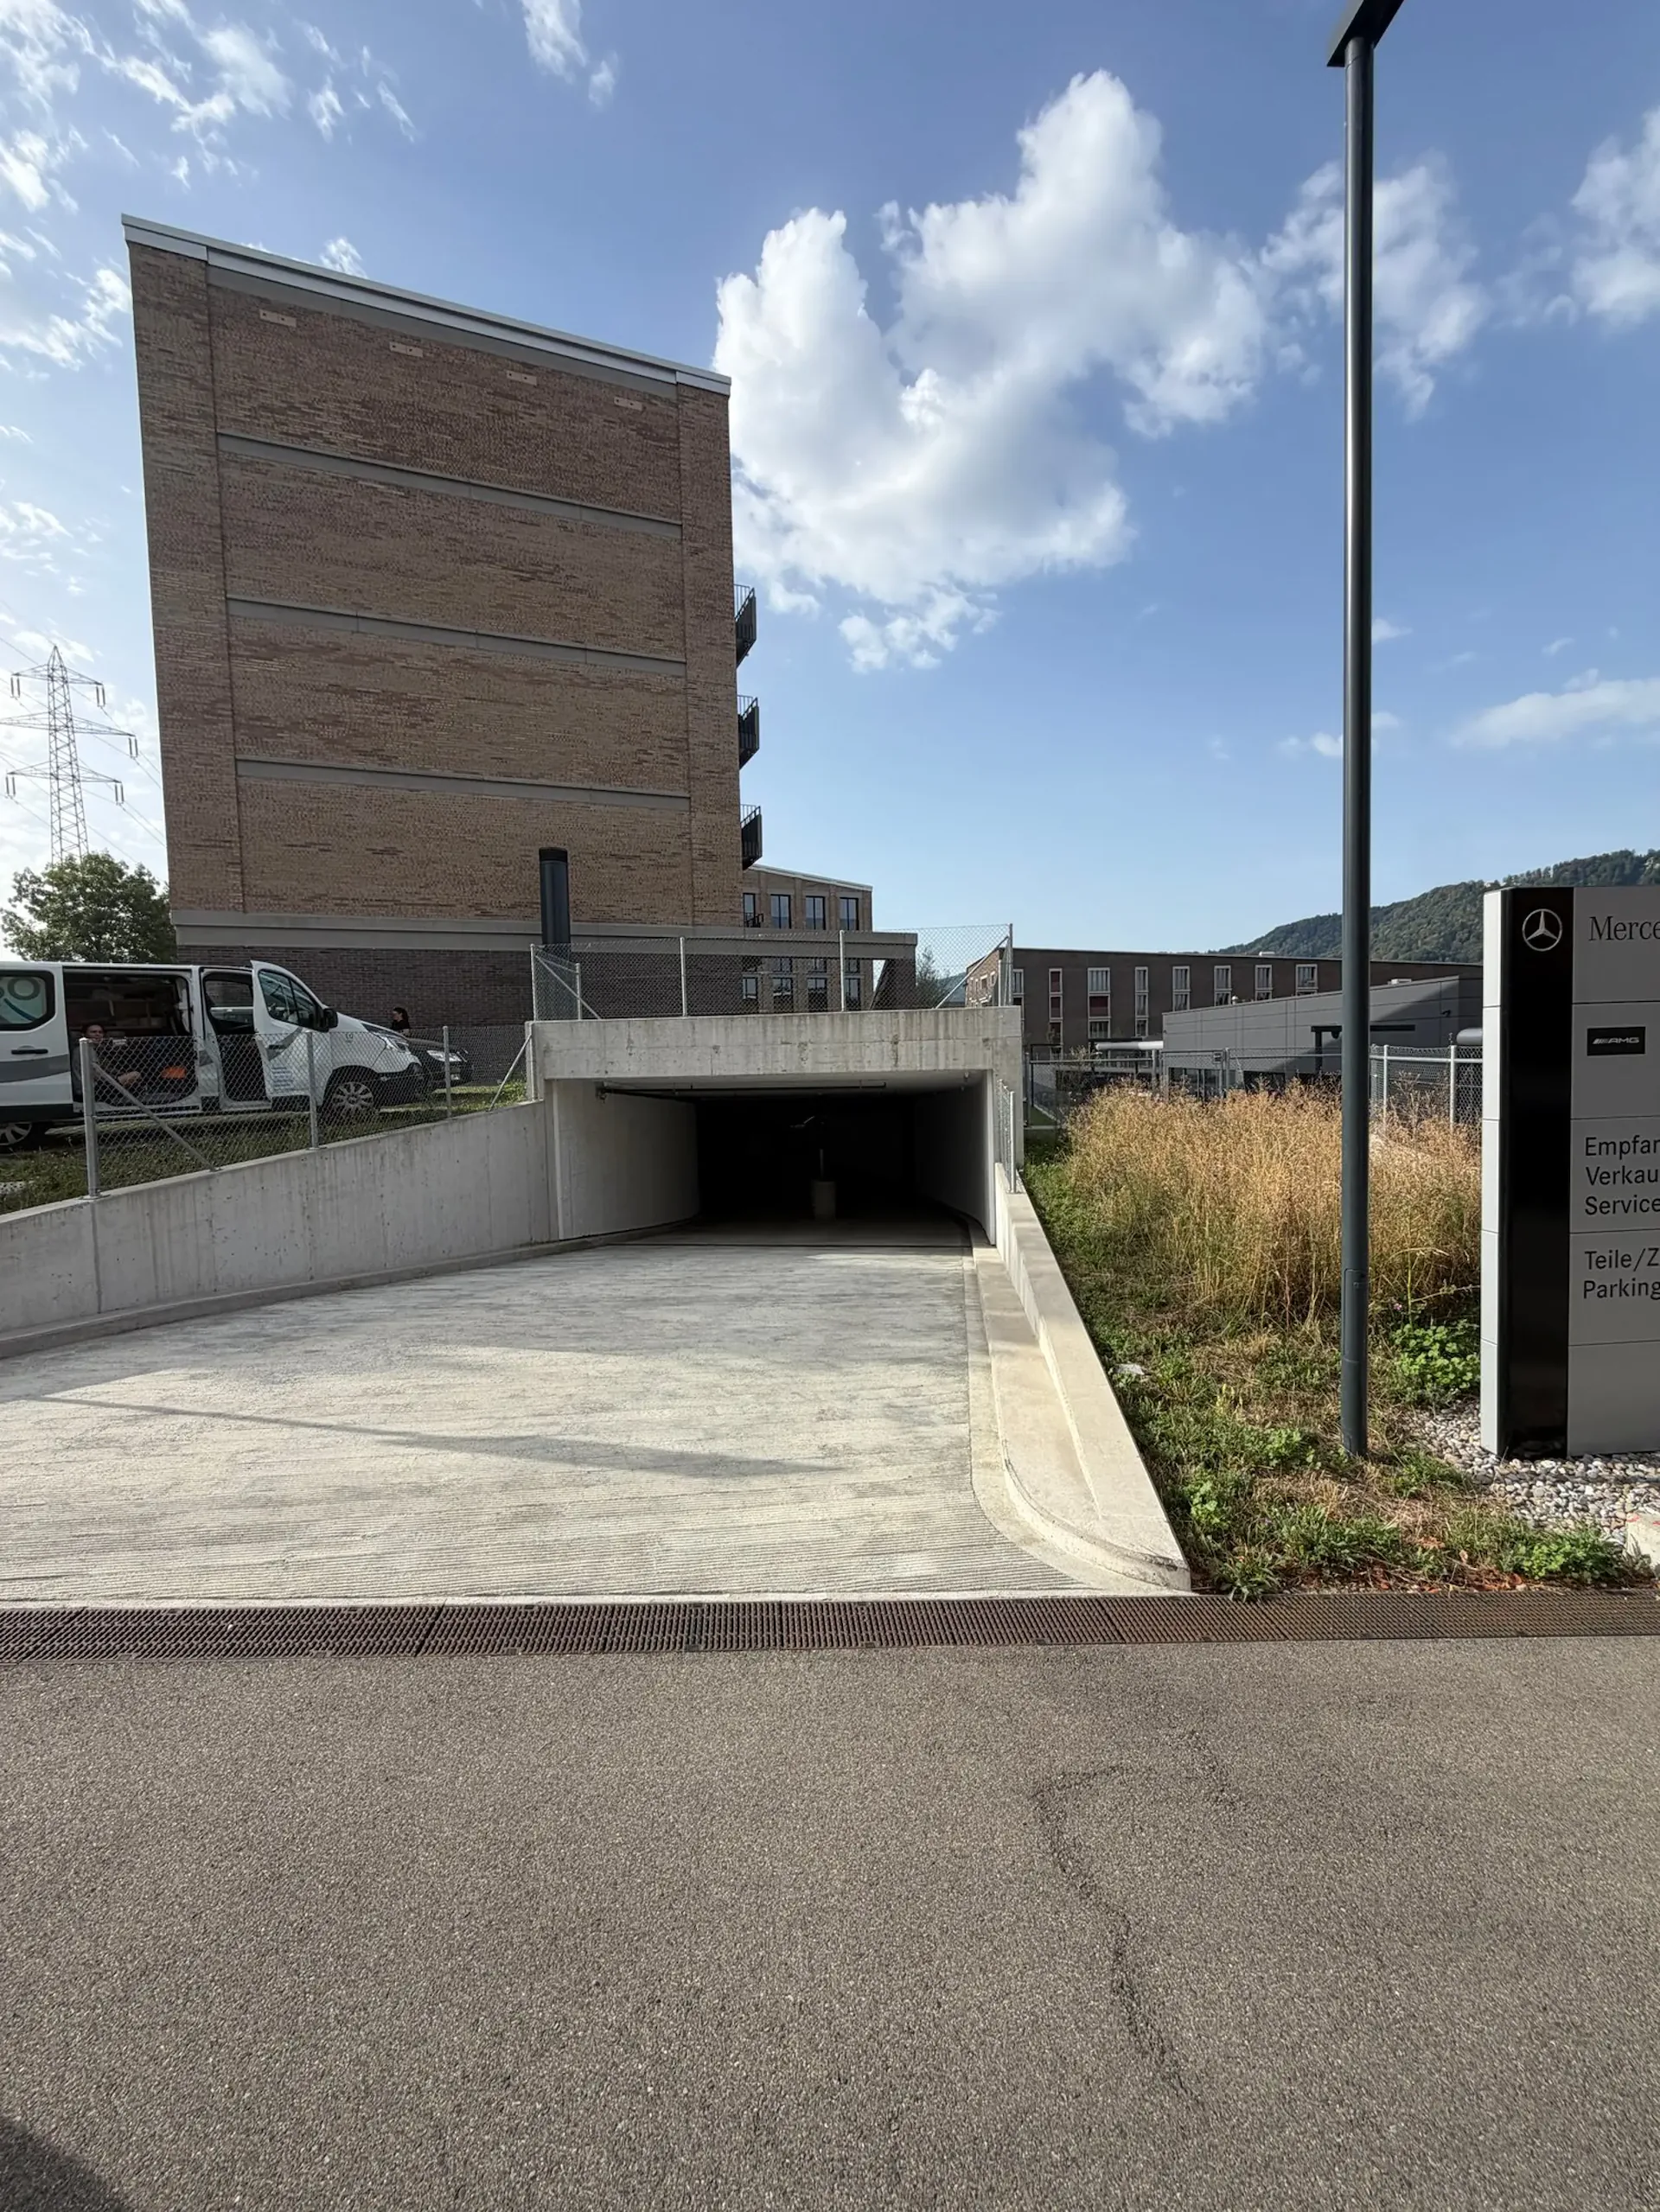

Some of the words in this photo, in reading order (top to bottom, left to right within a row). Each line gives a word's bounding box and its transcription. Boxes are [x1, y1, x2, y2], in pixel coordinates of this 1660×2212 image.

[1588, 915, 1660, 941] Merce
[1585, 1165, 1659, 1186] Verkau
[1585, 1194, 1660, 1216] Service
[1584, 1247, 1660, 1272] Teile/Z
[1583, 1277, 1660, 1301] Parking
